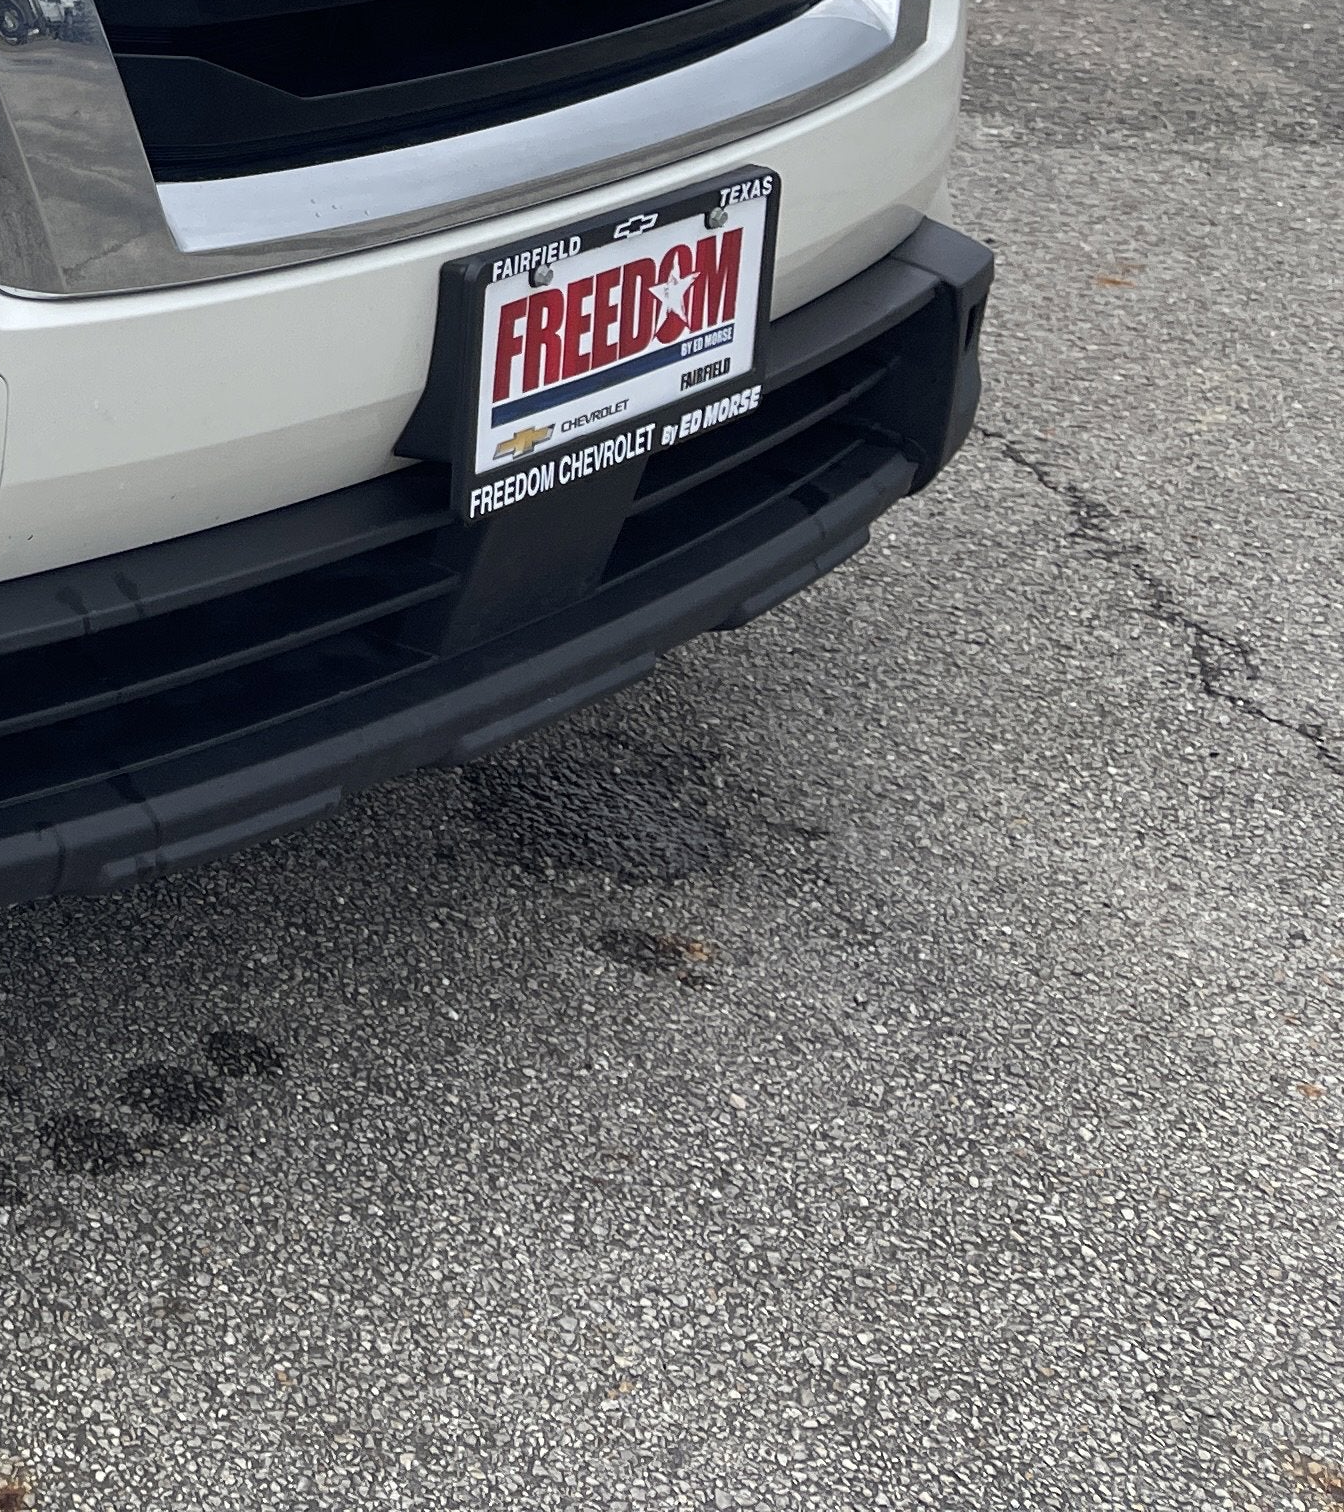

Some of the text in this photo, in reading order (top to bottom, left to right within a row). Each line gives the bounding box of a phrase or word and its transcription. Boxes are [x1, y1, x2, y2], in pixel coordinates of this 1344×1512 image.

[720, 175, 774, 207] TEXAS
[492, 235, 582, 282] FAIRFIELD
[492, 227, 744, 403] FREEDOM
[680, 327, 733, 357] BY ED MORSE
[680, 357, 731, 391] FAIRFIELD
[561, 399, 629, 433] CHEVROLET
[469, 460, 556, 519] FREEDOM
[558, 422, 656, 475] CHEVROLET
[678, 408, 703, 439] ED
[702, 384, 762, 429] MORSE
